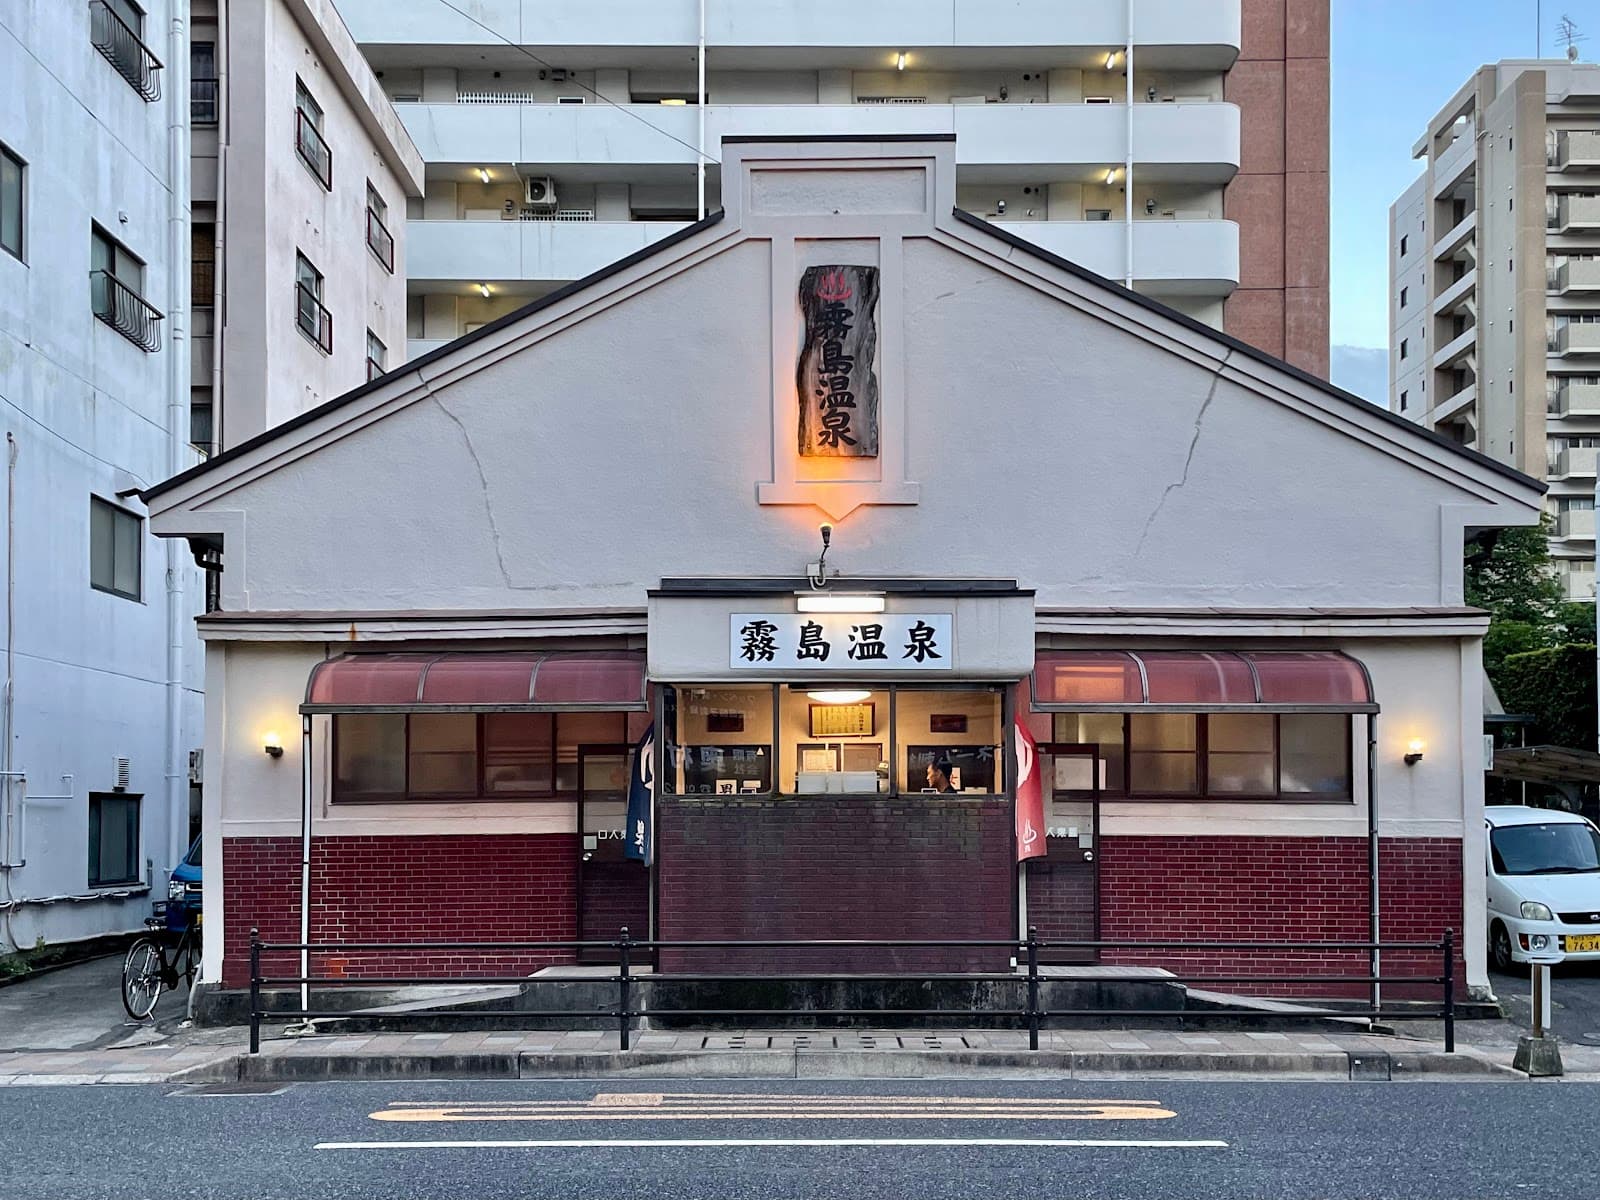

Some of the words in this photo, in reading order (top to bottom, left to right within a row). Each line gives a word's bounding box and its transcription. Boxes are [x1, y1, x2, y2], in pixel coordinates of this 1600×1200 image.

[816, 302, 857, 448] 霧島温泉
[739, 620, 943, 662] 霧島温泉
